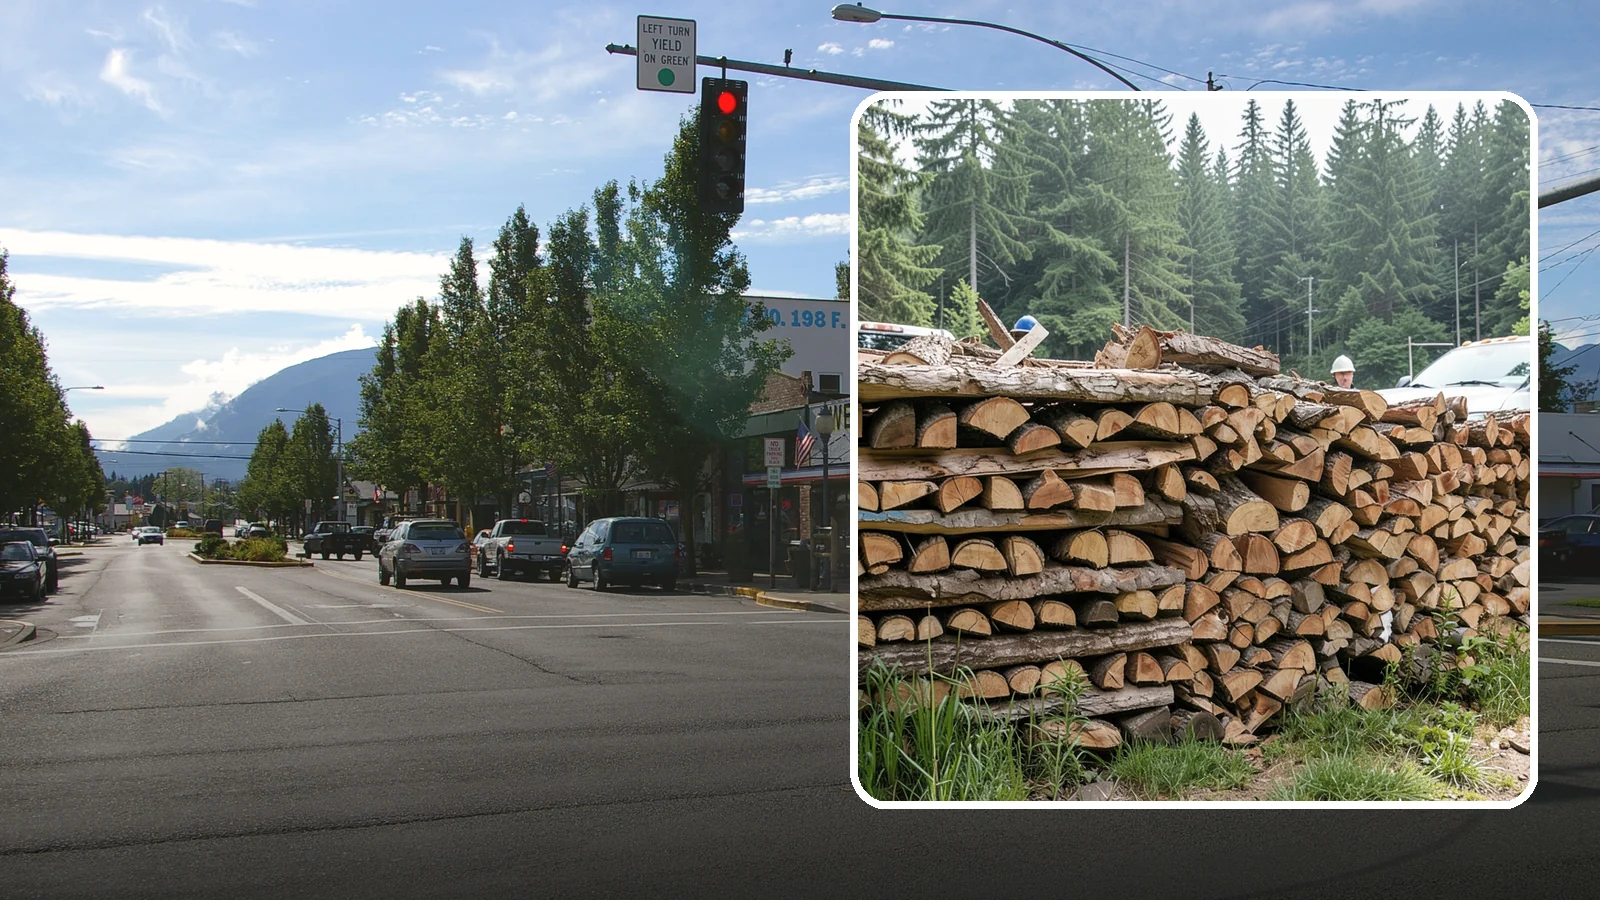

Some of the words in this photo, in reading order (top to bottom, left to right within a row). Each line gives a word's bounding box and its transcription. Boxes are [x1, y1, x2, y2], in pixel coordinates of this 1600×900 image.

[643, 23, 663, 34] LEFT
[668, 25, 690, 37] TURN
[652, 38, 682, 52] YIELD
[644, 53, 656, 64] ON
[661, 54, 689, 66] GREEN
[761, 308, 786, 328] O.
[791, 309, 826, 328] 198
[831, 311, 846, 329] F.
